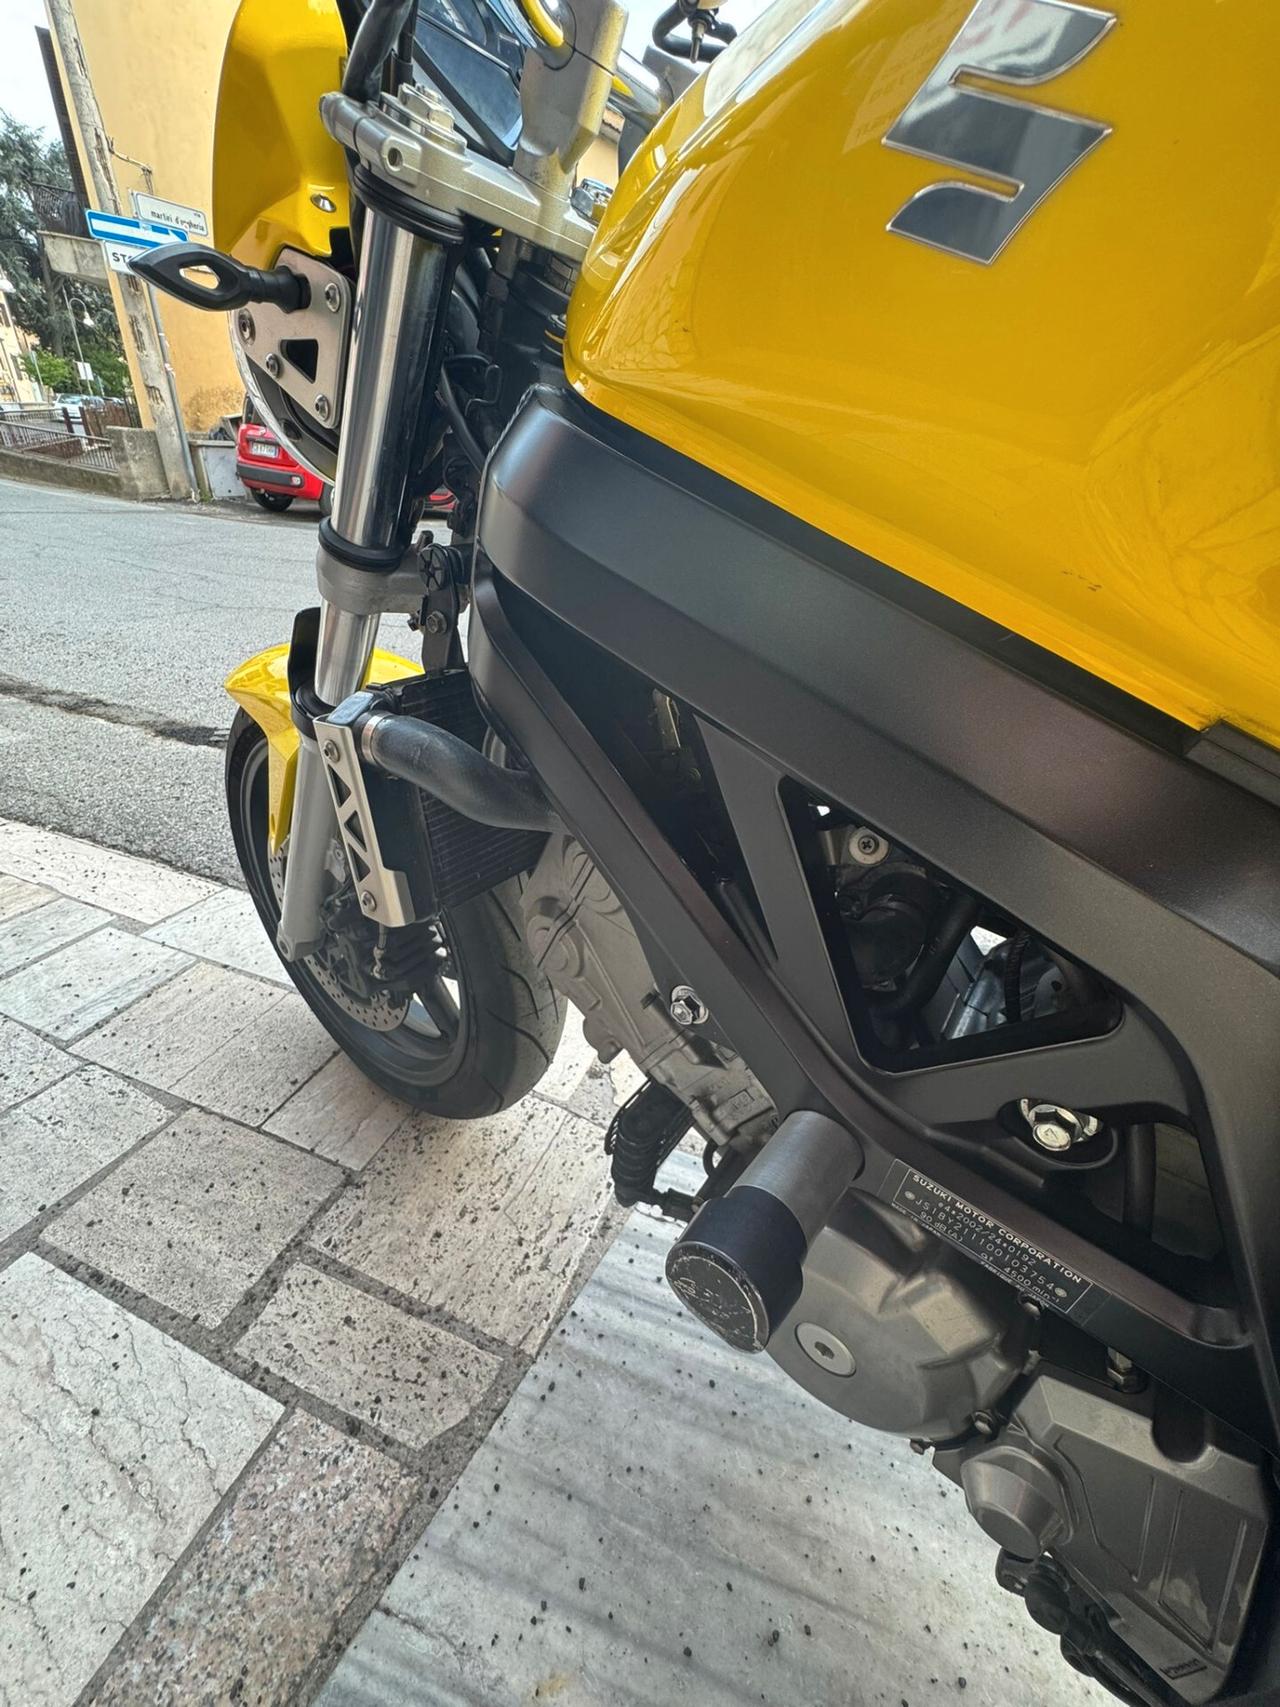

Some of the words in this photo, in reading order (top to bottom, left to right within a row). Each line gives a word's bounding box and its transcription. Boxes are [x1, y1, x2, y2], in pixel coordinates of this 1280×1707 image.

[912, 1174, 952, 1202] SUZUKI
[955, 1201, 995, 1229] MOTOR
[998, 1228, 1082, 1283] CORPORATION
[920, 1211, 932, 1222] 90
[1003, 1267, 1031, 1286] 4500
